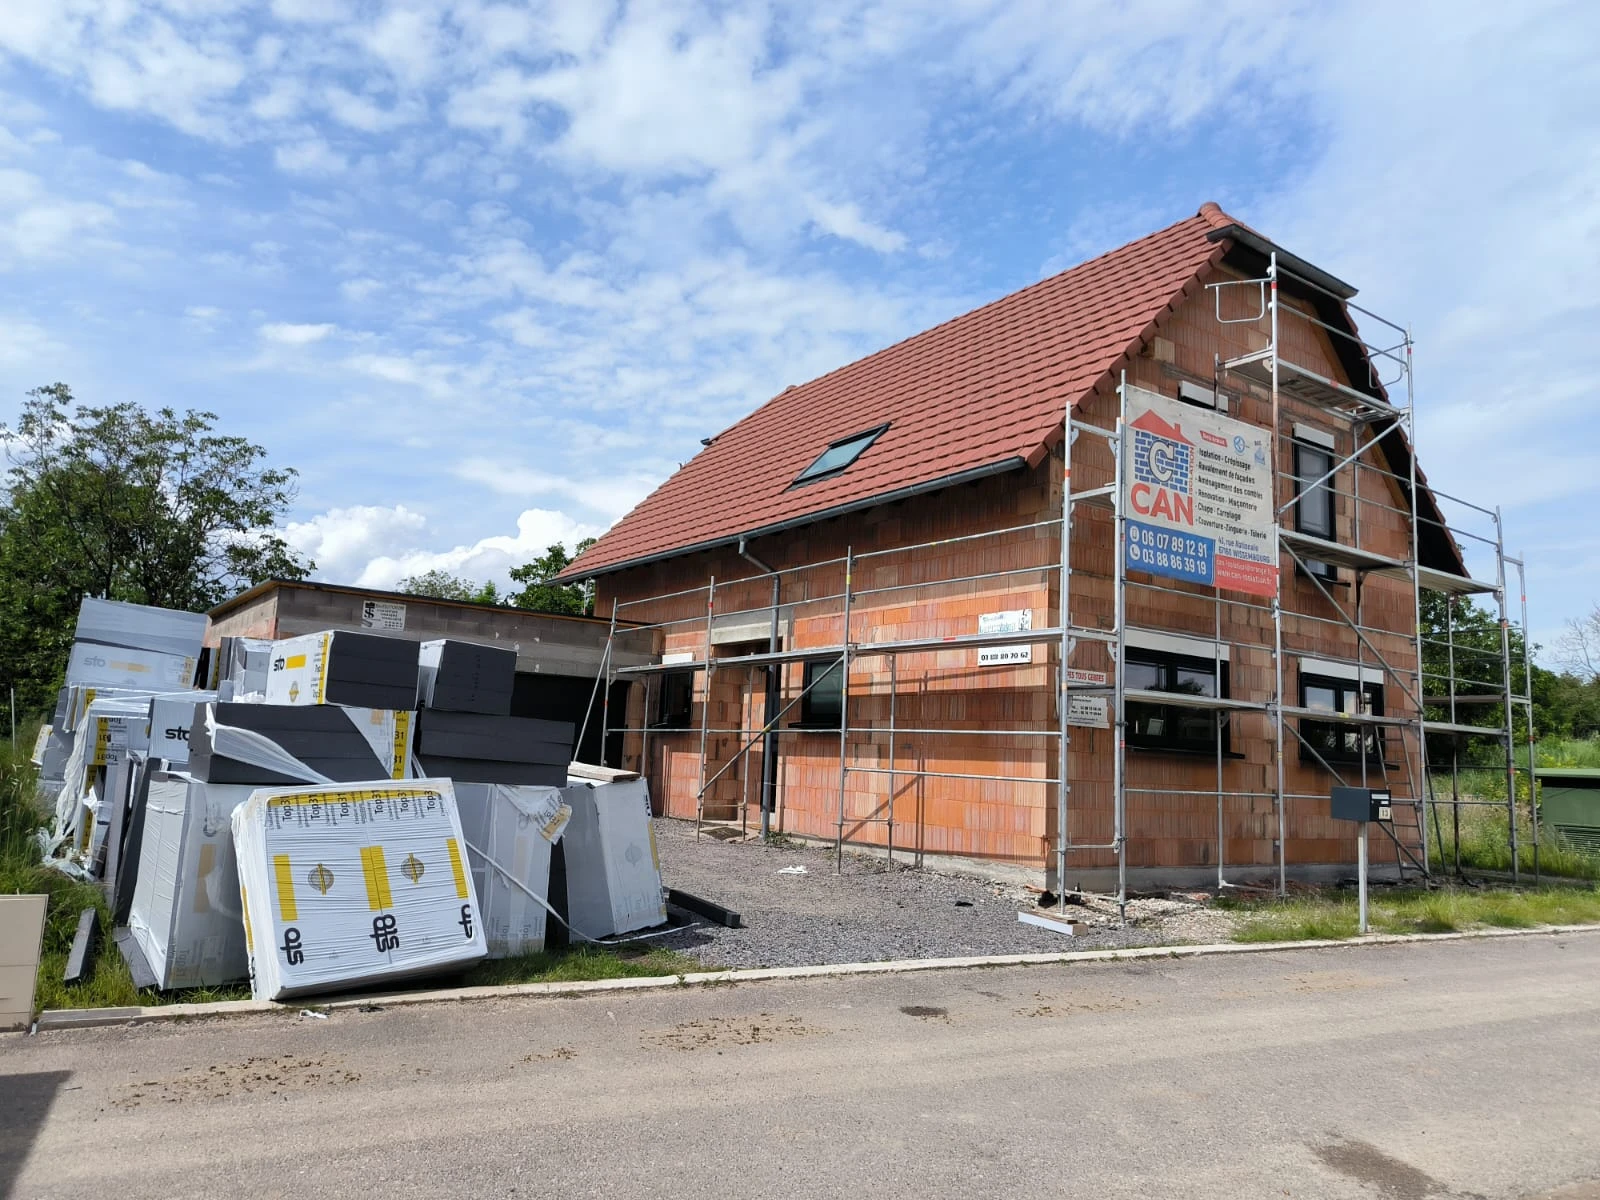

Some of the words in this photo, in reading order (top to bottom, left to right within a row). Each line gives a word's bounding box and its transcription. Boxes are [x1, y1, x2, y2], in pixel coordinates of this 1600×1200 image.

[1148, 440, 1175, 482] C
[1199, 447, 1221, 462] Isolation
[1224, 455, 1251, 471] Crépissage
[1198, 461, 1228, 477] Ravalement
[1234, 472, 1255, 484] façades
[1233, 485, 1243, 494] des
[1244, 489, 1263, 499] combles
[1131, 482, 1194, 526] CAN
[1197, 502, 1213, 514] Chape
[1216, 507, 1241, 522] Carrelage
[1228, 497, 1257, 512] Maçonnerie
[1198, 516, 1224, 530] Couverture
[1142, 530, 1154, 546] 06
[1157, 533, 1169, 550] 07
[1171, 536, 1184, 553] 89
[1186, 540, 1196, 556] 12
[1198, 542, 1207, 558] 91
[1142, 548, 1154, 564] 03
[1157, 552, 1168, 567] 88
[1170, 554, 1182, 570] 86
[1184, 557, 1195, 573] 39
[1197, 560, 1207, 576] 19
[1233, 549, 1270, 563] WISSEMBOURG
[83, 656, 106, 668] sto
[1076, 672, 1087, 681] TOUS
[1088, 673, 1104, 682] GENRES
[308, 794, 321, 820] Top31
[337, 793, 350, 818] Top31
[280, 927, 304, 965] sto
